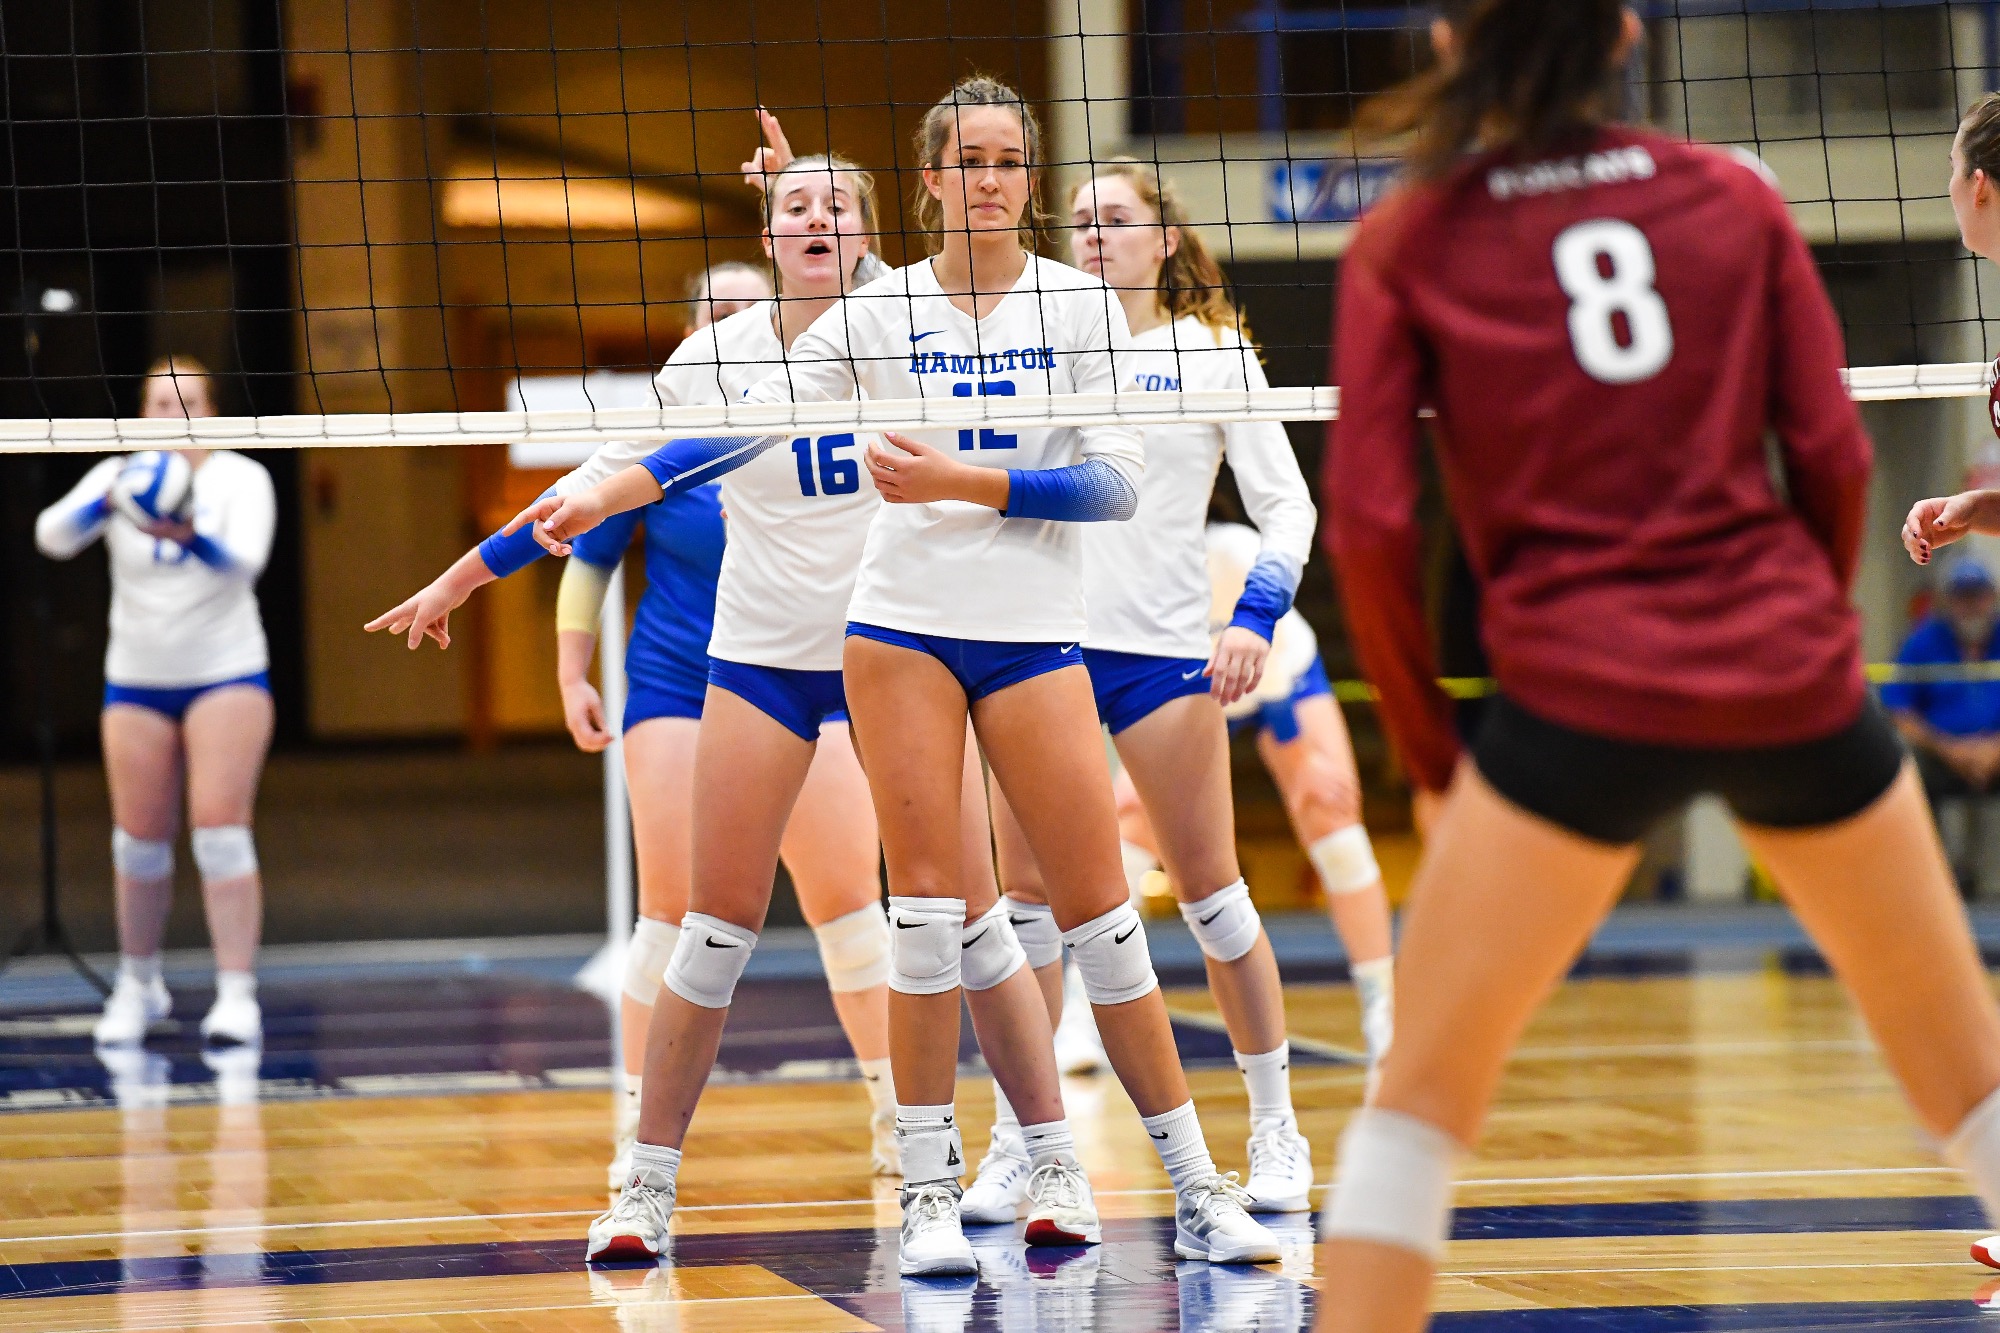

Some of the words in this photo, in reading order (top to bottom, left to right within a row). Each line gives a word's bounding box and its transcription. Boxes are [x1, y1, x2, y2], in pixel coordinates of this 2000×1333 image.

[1552, 216, 1674, 385] 8
[909, 347, 1056, 374] HAMILTON
[792, 433, 859, 497] 16
